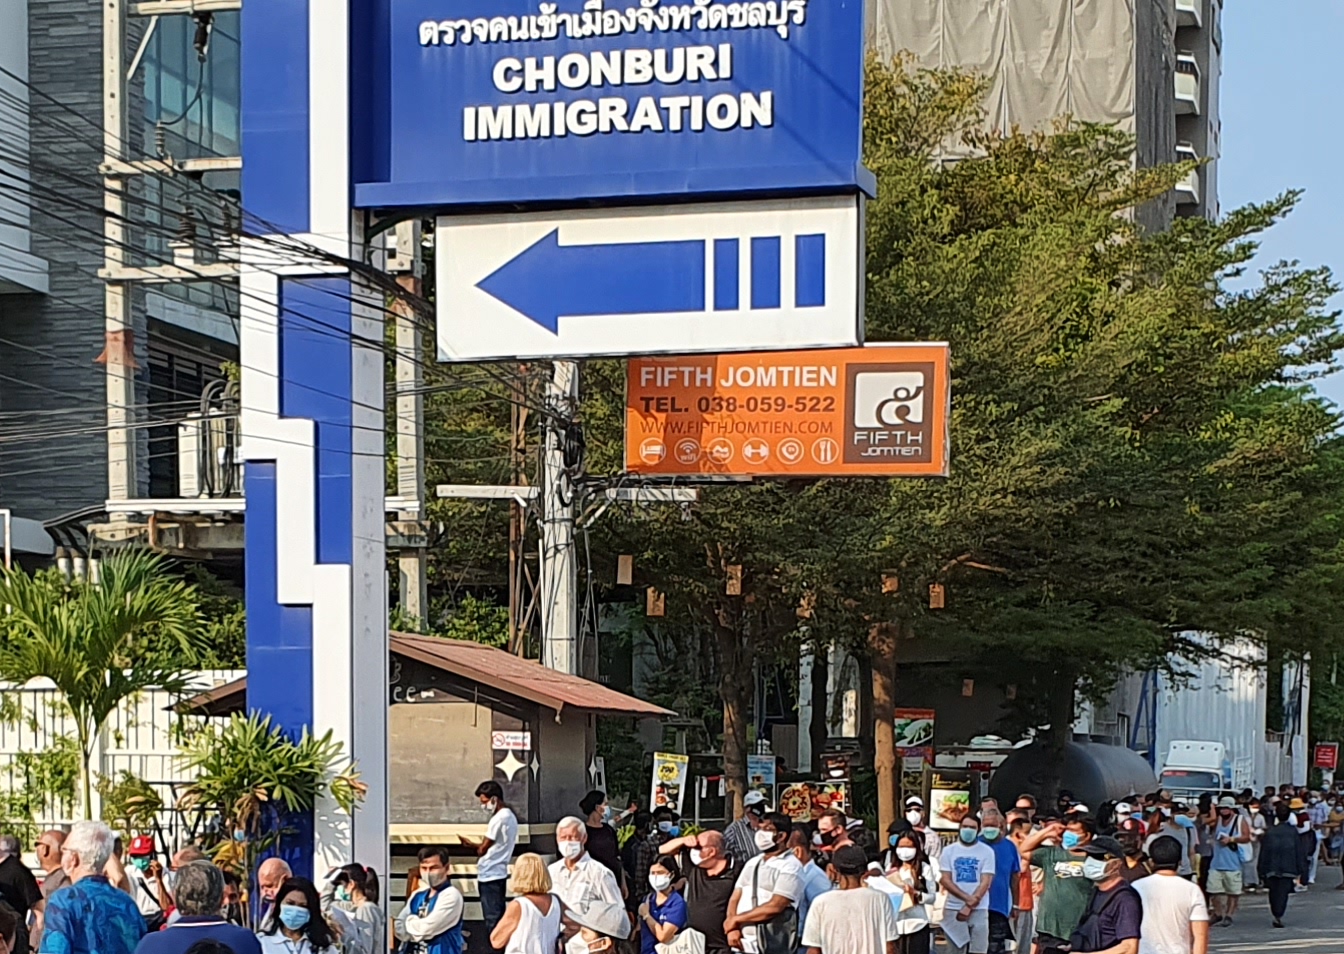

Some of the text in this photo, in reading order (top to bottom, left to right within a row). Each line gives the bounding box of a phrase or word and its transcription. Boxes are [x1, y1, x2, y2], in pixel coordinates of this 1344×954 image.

[492, 44, 732, 93] CHONBURI
[463, 91, 773, 142] IMMIGRATION
[640, 366, 837, 388] FIFTH JOMTIEN
[640, 395, 836, 413] TEL. 038-059-522
[640, 420, 833, 435] WWW.FIFTHJOMTIEN.COM
[854, 431, 923, 445] FIFTH
